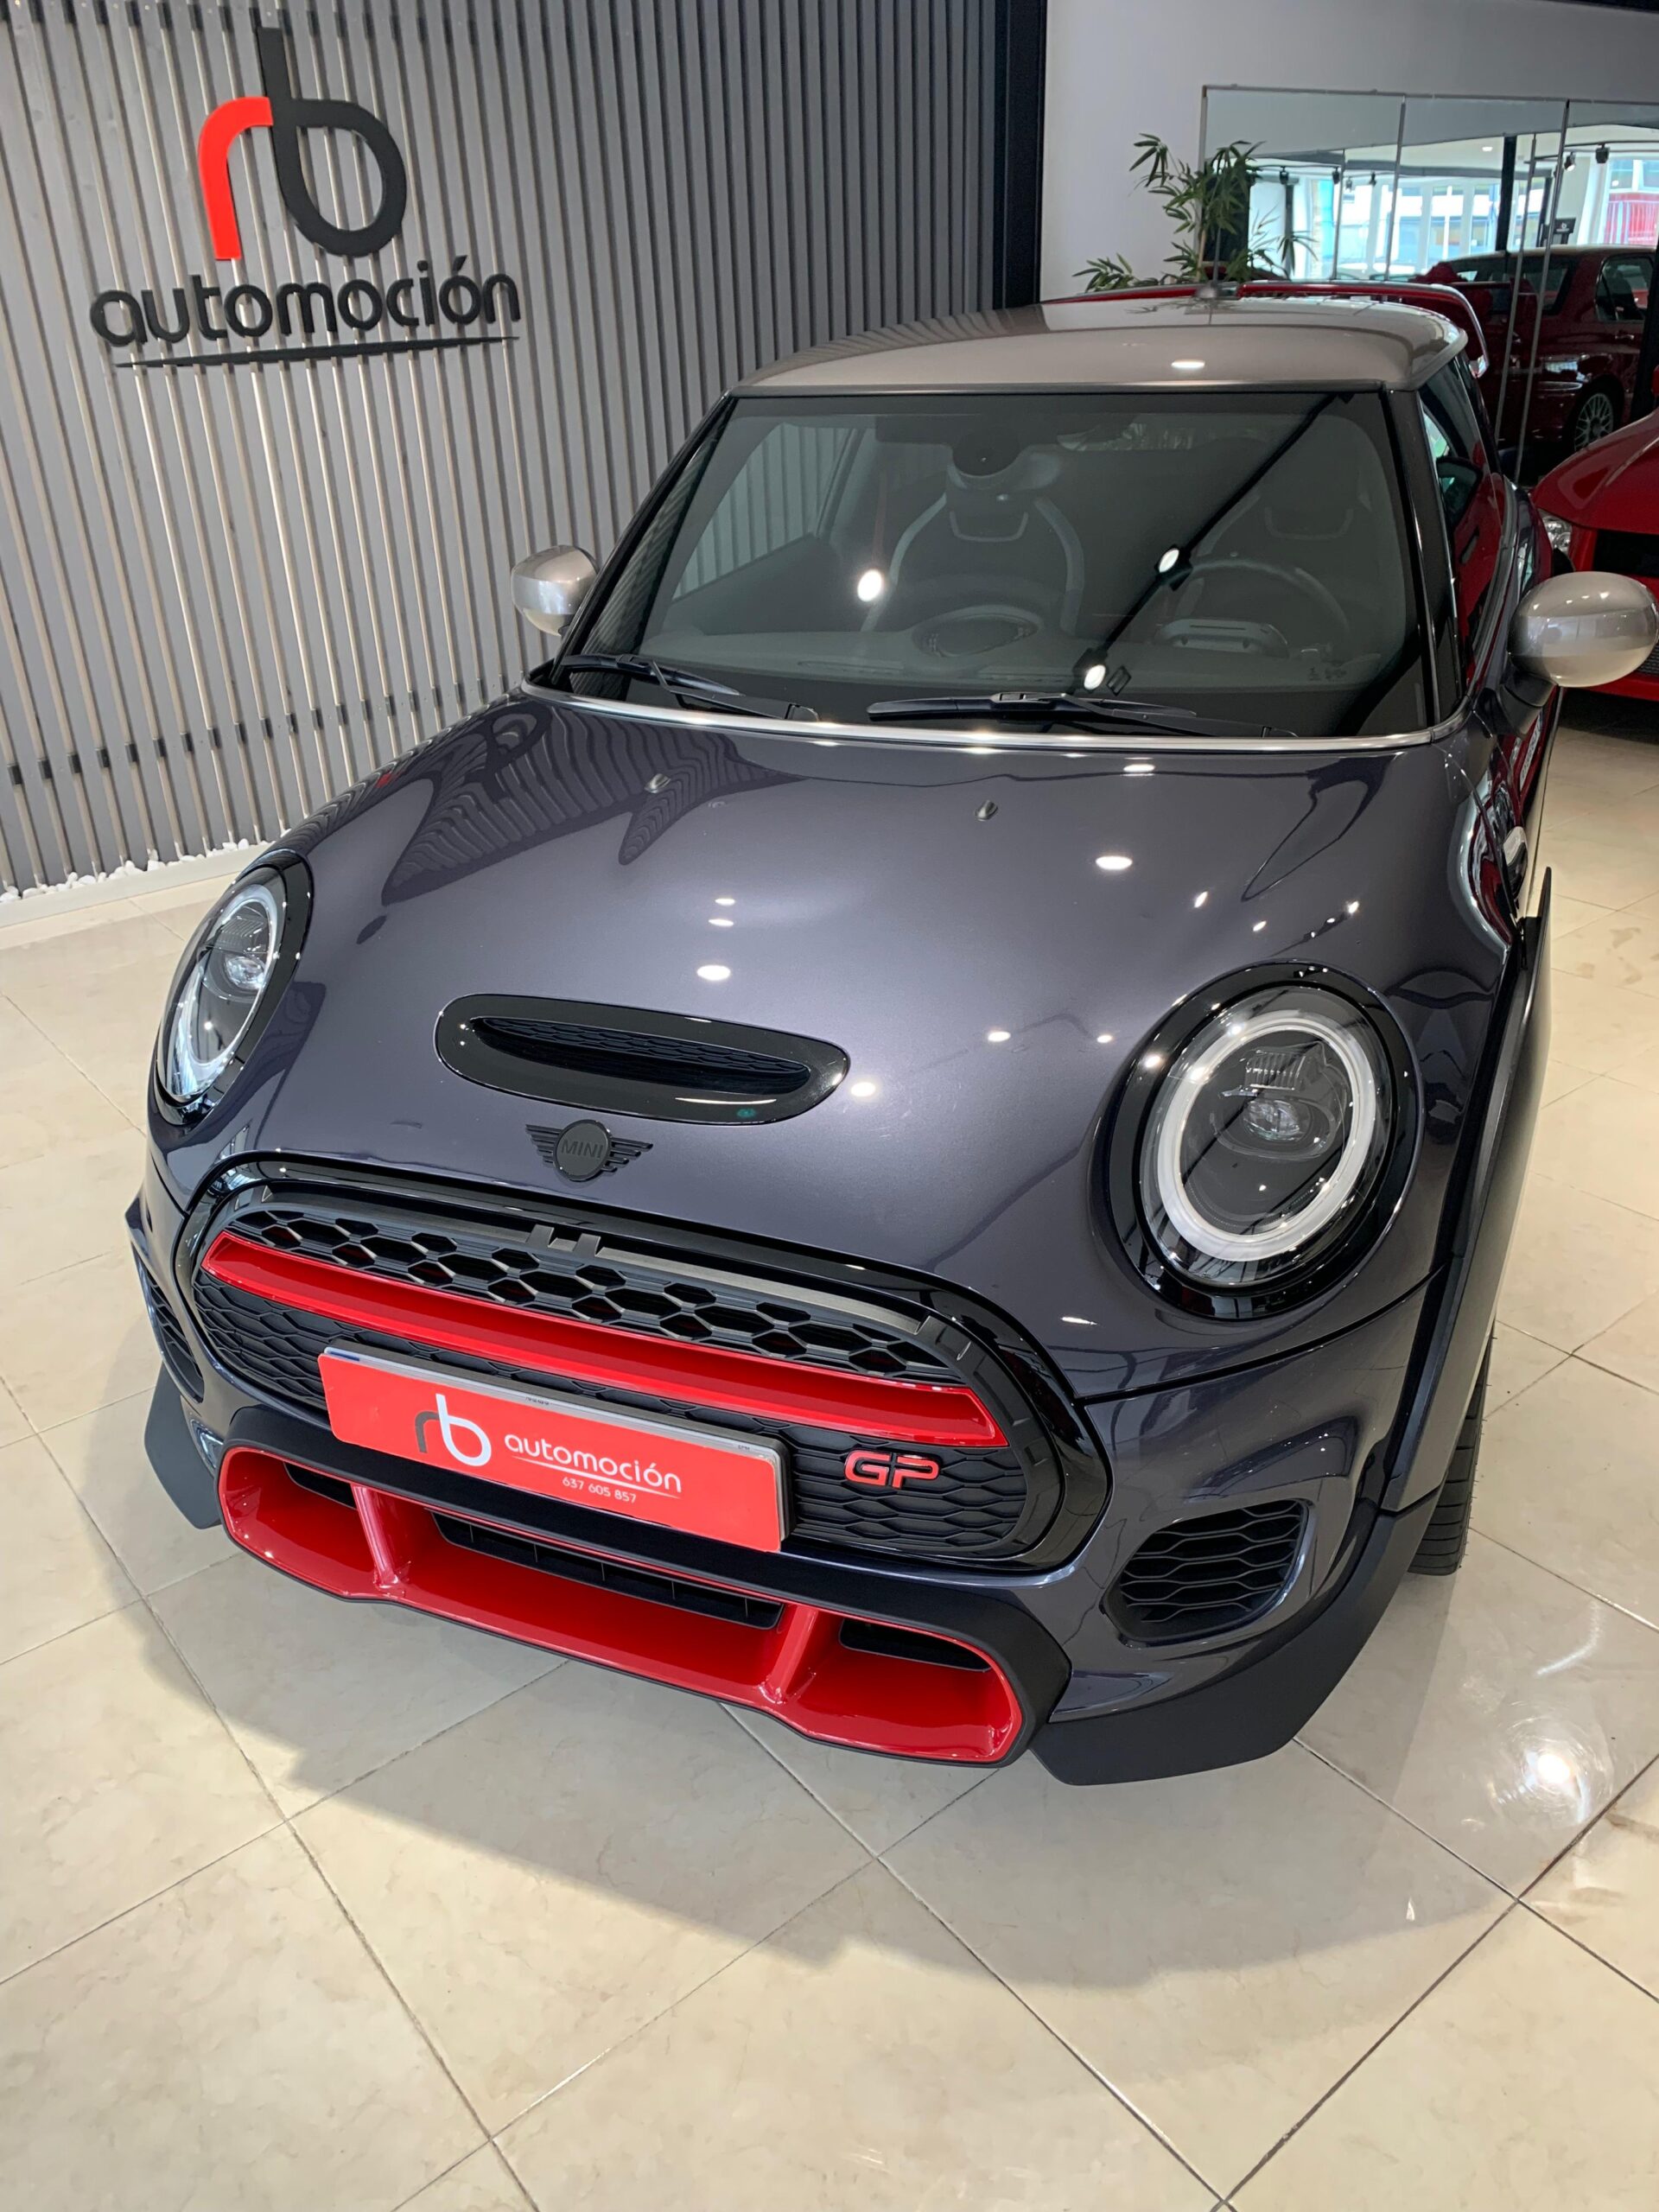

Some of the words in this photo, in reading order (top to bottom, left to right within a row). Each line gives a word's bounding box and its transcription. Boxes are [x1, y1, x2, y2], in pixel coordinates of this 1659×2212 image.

[198, 26, 407, 261] rb
[90, 255, 521, 346] automoción
[561, 1139, 604, 1159] MINI
[415, 1393, 492, 1466] rb
[504, 1433, 682, 1493] automoción
[562, 1476, 585, 1491] 637
[588, 1483, 611, 1497] 605
[613, 1489, 637, 1504] 857
[844, 1449, 940, 1491] GP
